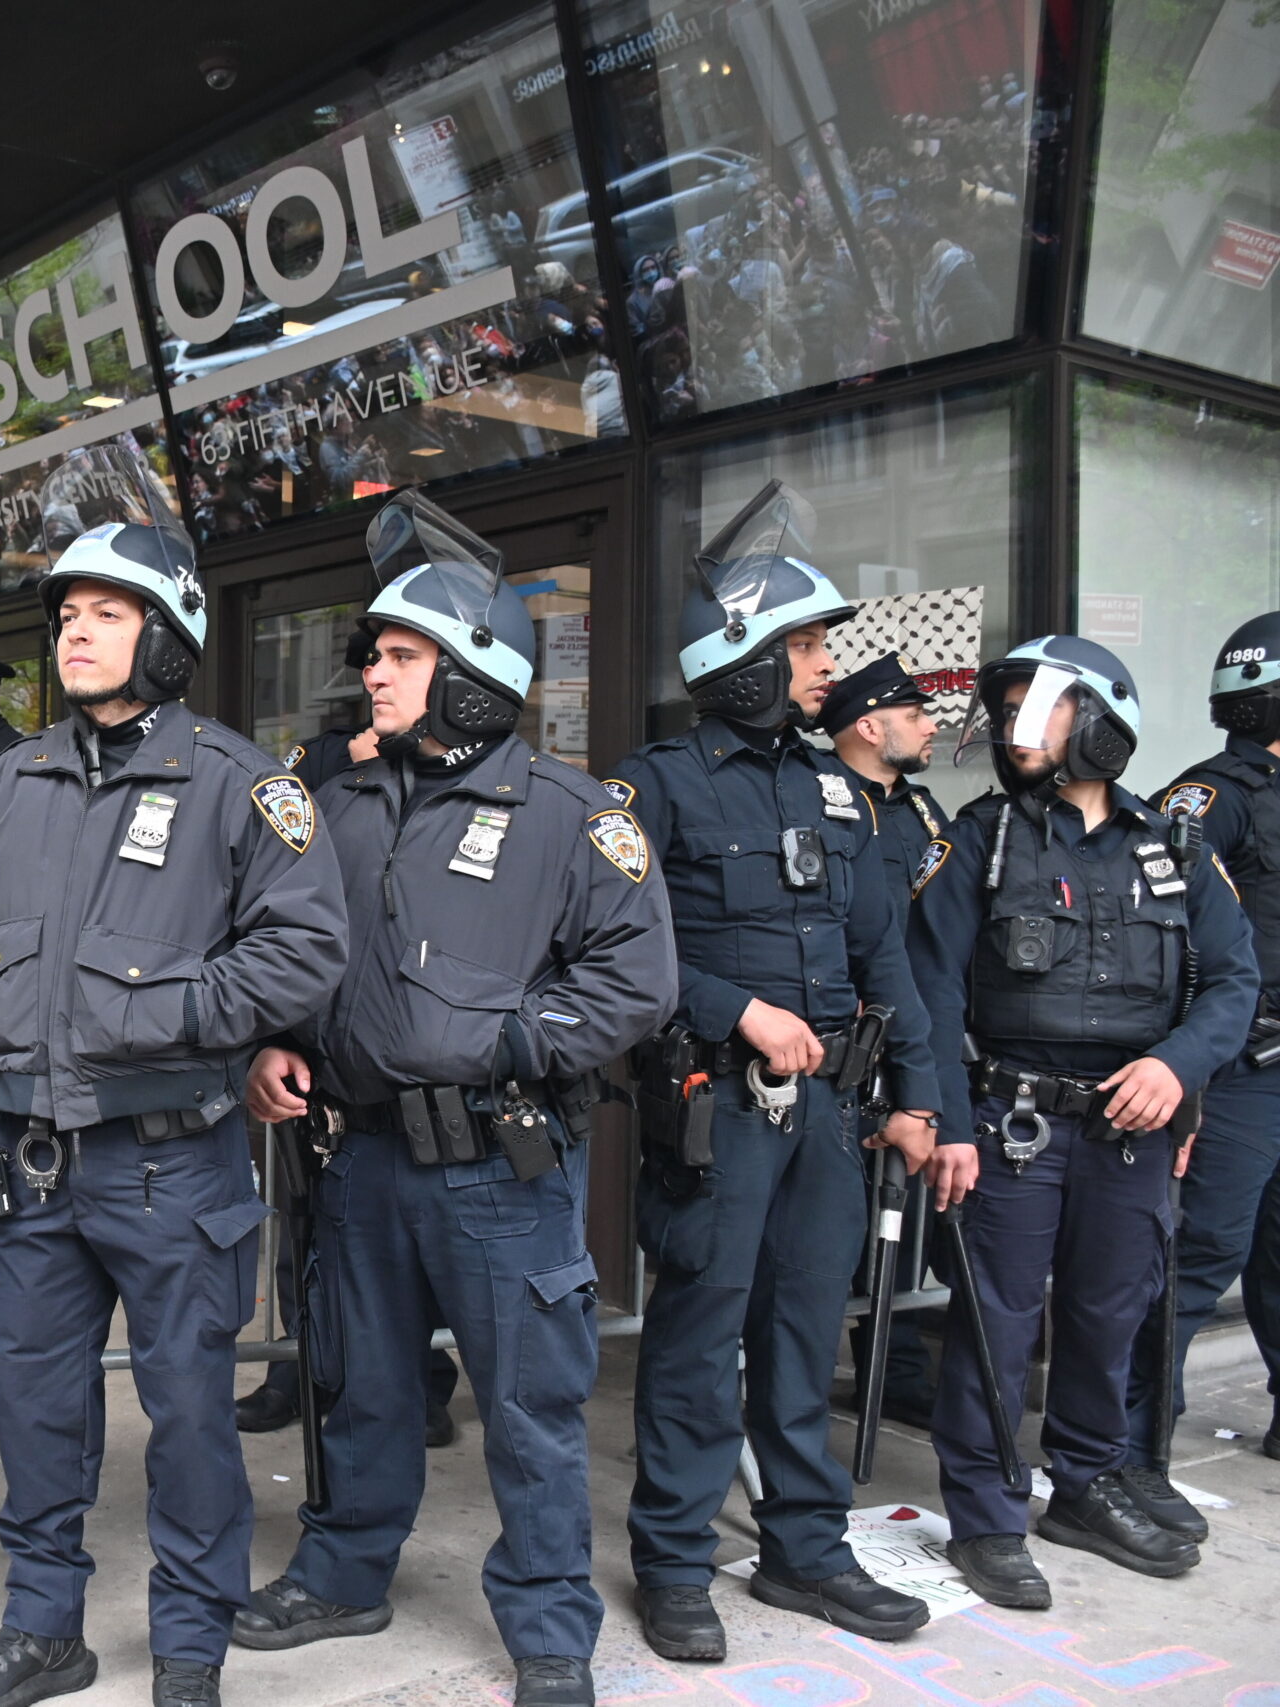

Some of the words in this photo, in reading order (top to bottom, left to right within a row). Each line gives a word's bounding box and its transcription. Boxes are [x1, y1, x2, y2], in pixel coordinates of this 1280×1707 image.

[200, 427, 231, 466] 63
[236, 398, 324, 456] FIFTH
[332, 346, 489, 428] AVENUE
[1224, 647, 1266, 665] 1980
[265, 780, 292, 793] POLICE
[261, 788, 303, 806] DEPARTMENT
[268, 812, 284, 830] CITY
[282, 829, 294, 841] OF
[599, 814, 625, 826] POLICE
[593, 821, 636, 838] DEPARTMENT
[601, 844, 618, 860] CITY
[852, 1527, 932, 1545] MUST
